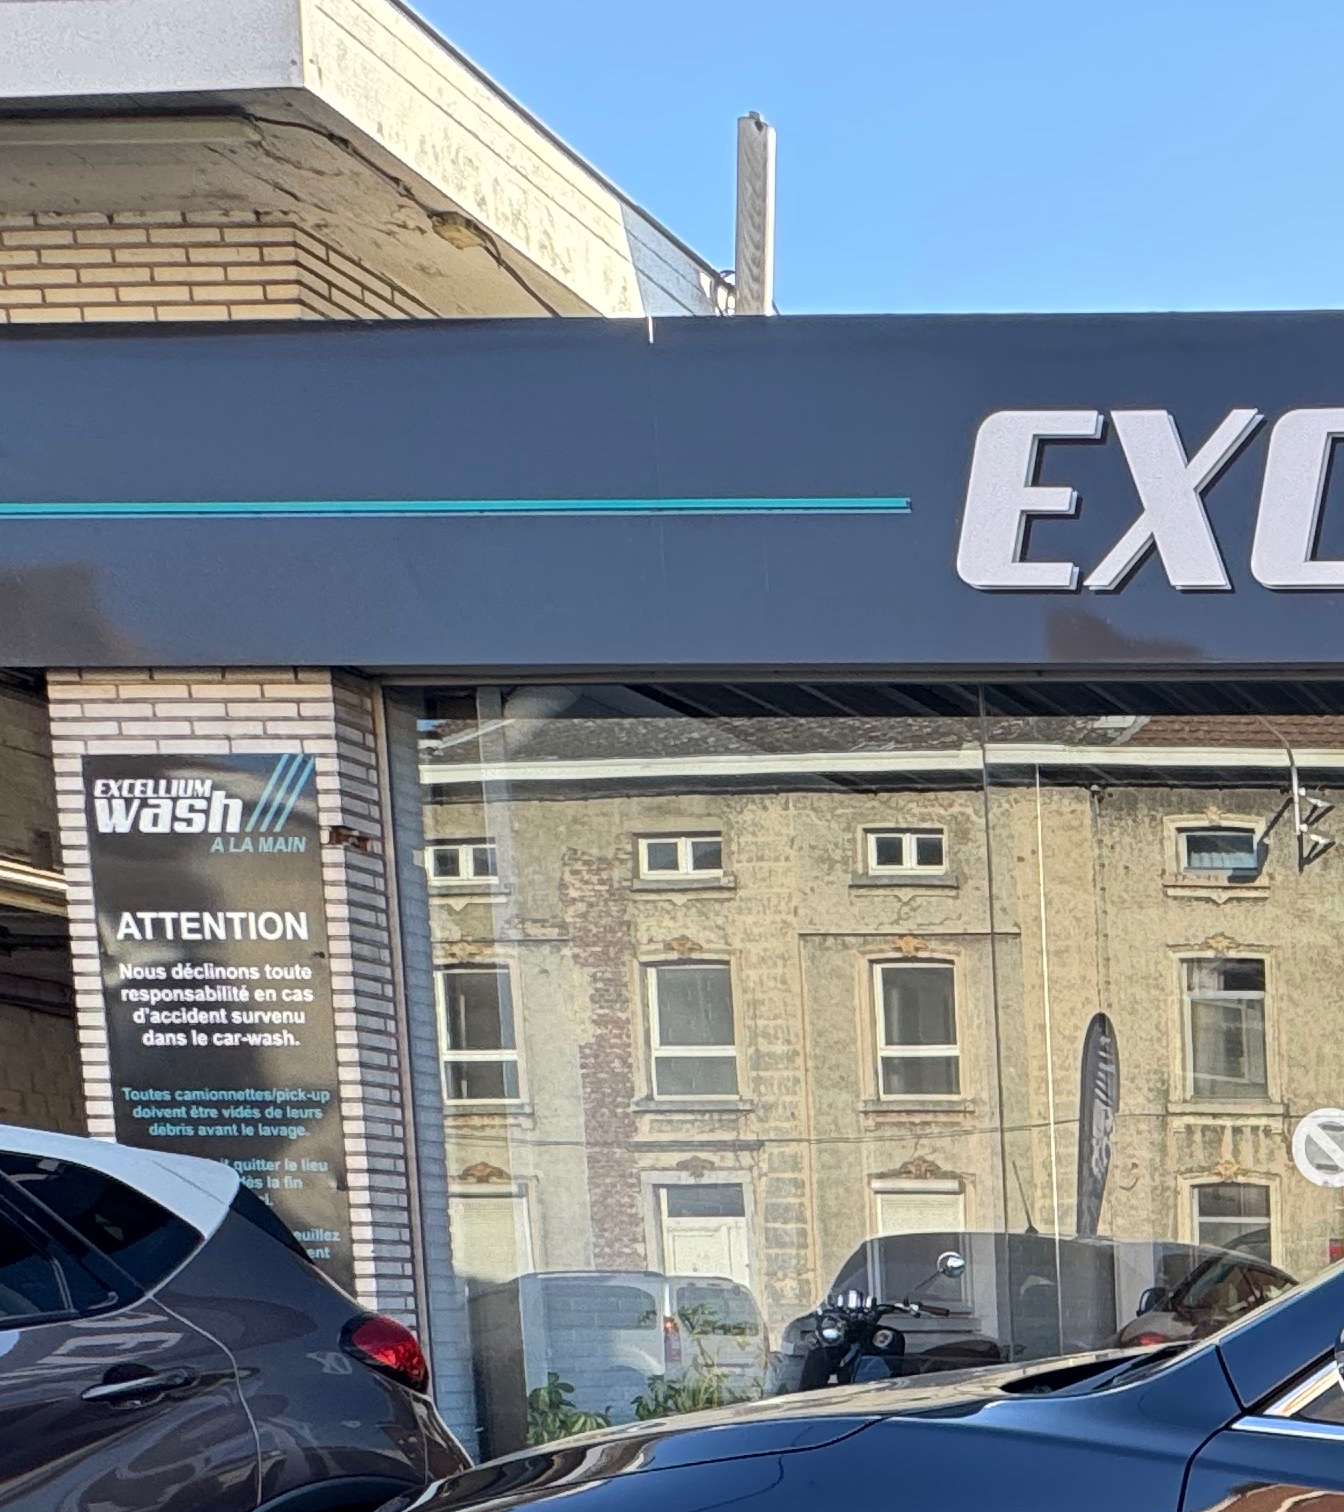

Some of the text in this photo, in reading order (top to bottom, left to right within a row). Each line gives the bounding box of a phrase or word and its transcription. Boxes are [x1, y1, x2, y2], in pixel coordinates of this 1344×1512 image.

[94, 778, 213, 797] EXCELLIUM
[94, 790, 244, 834] wash
[209, 836, 307, 854] A LA MAIN
[116, 911, 309, 941] ATTENTION
[118, 962, 313, 980] Nous déclinons toute
[120, 985, 314, 1006] responsabilité en cas
[132, 1007, 306, 1025] d'accident survenu
[141, 1029, 301, 1047] dans le car-wash.
[121, 1087, 331, 1104] Toutes camionnettes/pick-up
[132, 1104, 323, 1119] doivent être vidés de leurs
[148, 1122, 312, 1140] débris avant le lavage.
[232, 1157, 280, 1174] quitter
[284, 1157, 298, 1172] le
[301, 1157, 329, 1172] lieu
[266, 1175, 280, 1190] la
[283, 1175, 304, 1190] fin
